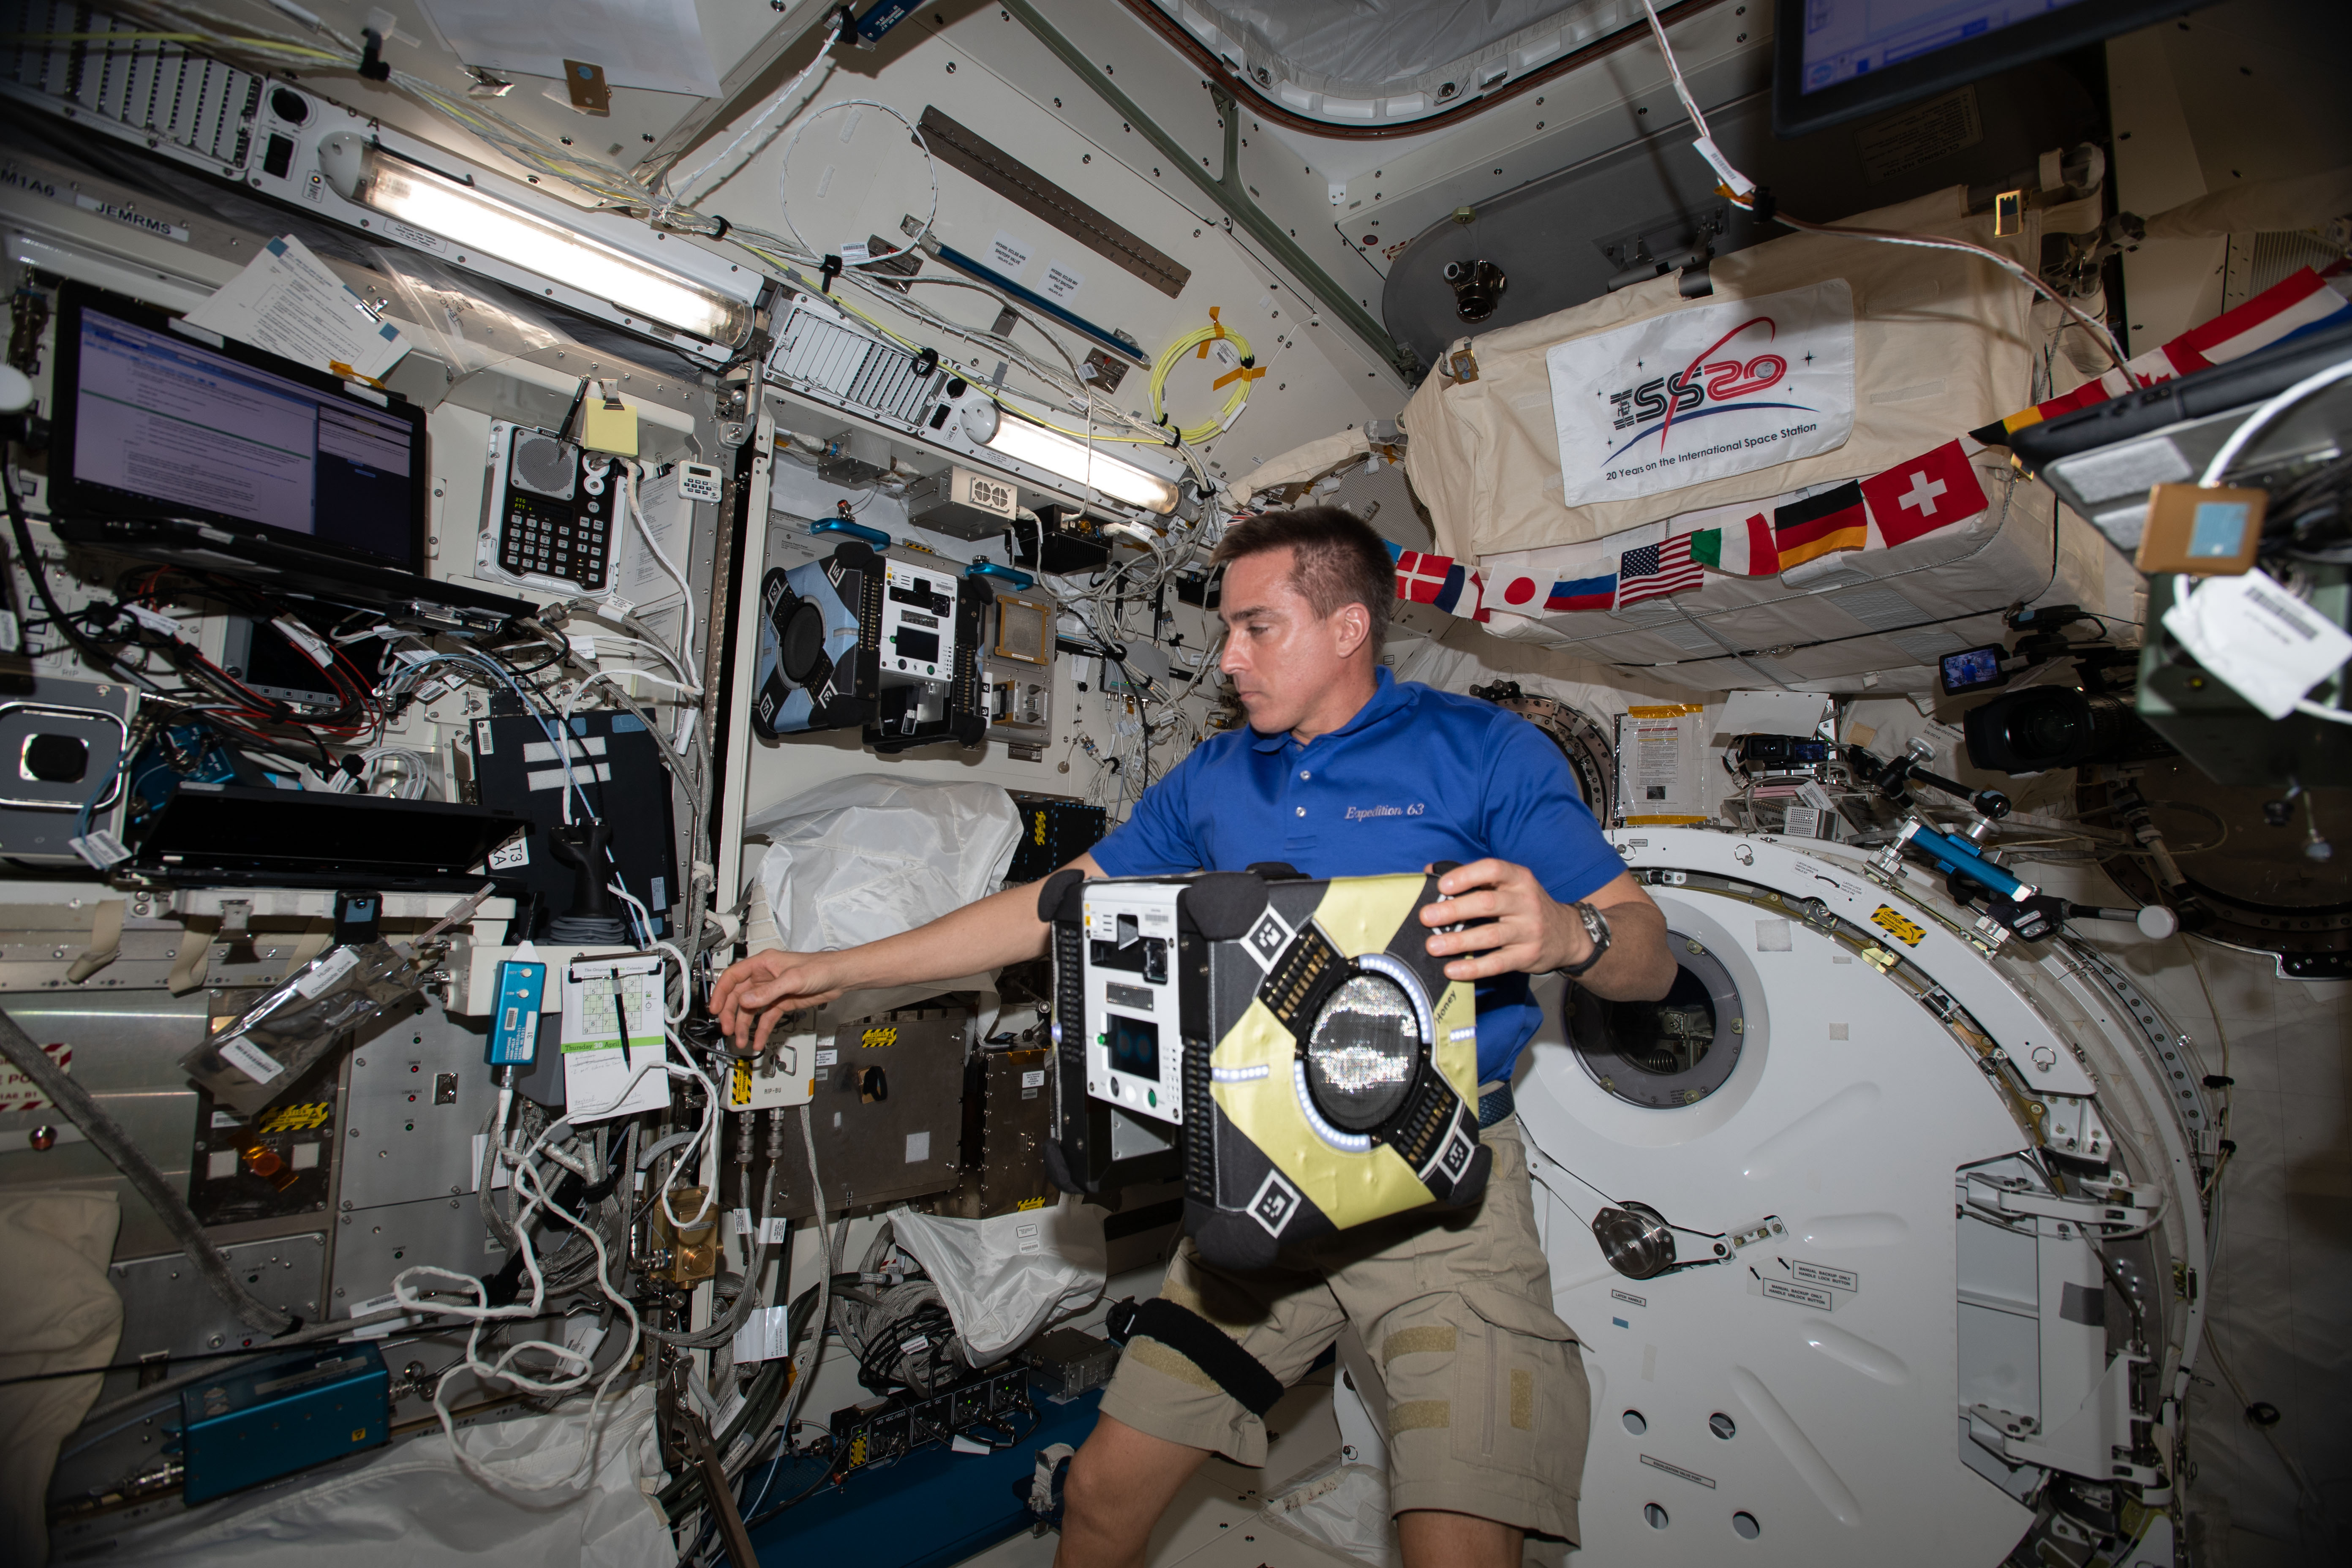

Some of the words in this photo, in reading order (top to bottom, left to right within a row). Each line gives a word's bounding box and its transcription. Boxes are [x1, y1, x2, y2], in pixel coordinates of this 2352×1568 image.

[1917, 143, 1960, 164] CLOSING
[1882, 162, 1914, 178] HATCH
[95, 203, 172, 235] JEMRMS
[995, 241, 1008, 251] HV3405:
[1008, 249, 1019, 257] ECLSS
[995, 248, 1010, 259] SHUTOFF
[1010, 257, 1021, 265] VALVE
[1049, 274, 1060, 283] SUPPLY
[1060, 280, 1074, 291] SHUTOFF
[1054, 283, 1064, 291] VALVE
[1062, 275, 1073, 283] ECLSS
[1606, 471, 1617, 481] 20
[1619, 464, 1644, 479] Years
[1645, 461, 1658, 471] on
[1659, 455, 1676, 467] the
[1679, 439, 1742, 462] International
[1744, 432, 1778, 448] Space
[1780, 422, 1817, 439] Station
[62, 669, 79, 677] RIP
[1345, 804, 1403, 822] Expedition
[1407, 803, 1425, 816] 63
[1884, 911, 1903, 926] CAUTION
[310, 971, 339, 995] Chocolate
[337, 959, 353, 975] Drink
[316, 964, 334, 979] Huski
[1435, 989, 1457, 1024] Honey
[1799, 1266, 1817, 1274] MANUAL
[1653, 1461, 1679, 1474] EQUALIZATION
